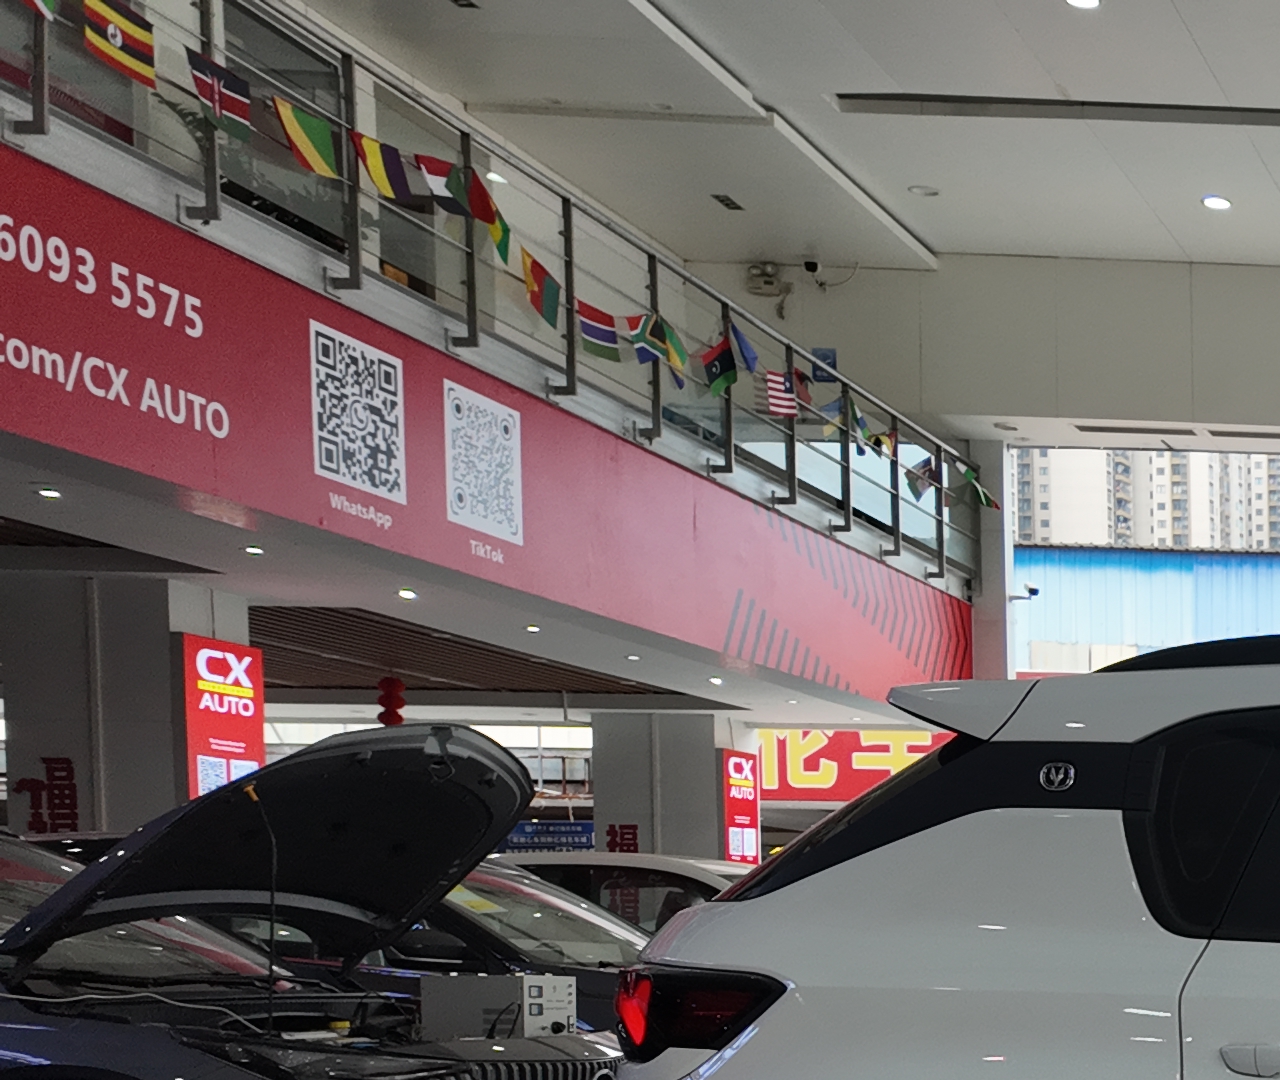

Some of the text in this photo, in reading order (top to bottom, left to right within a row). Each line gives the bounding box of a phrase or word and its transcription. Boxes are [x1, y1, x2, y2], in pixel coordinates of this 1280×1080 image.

[0, 214, 204, 338] 6093 5575
[140, 377, 230, 439] AUTO
[329, 492, 393, 530] WhatsApp
[469, 539, 504, 564] TikTok
[196, 648, 253, 688] CX
[199, 692, 255, 717] AUTO
[728, 757, 754, 780] CX
[730, 786, 754, 800] AUTO
